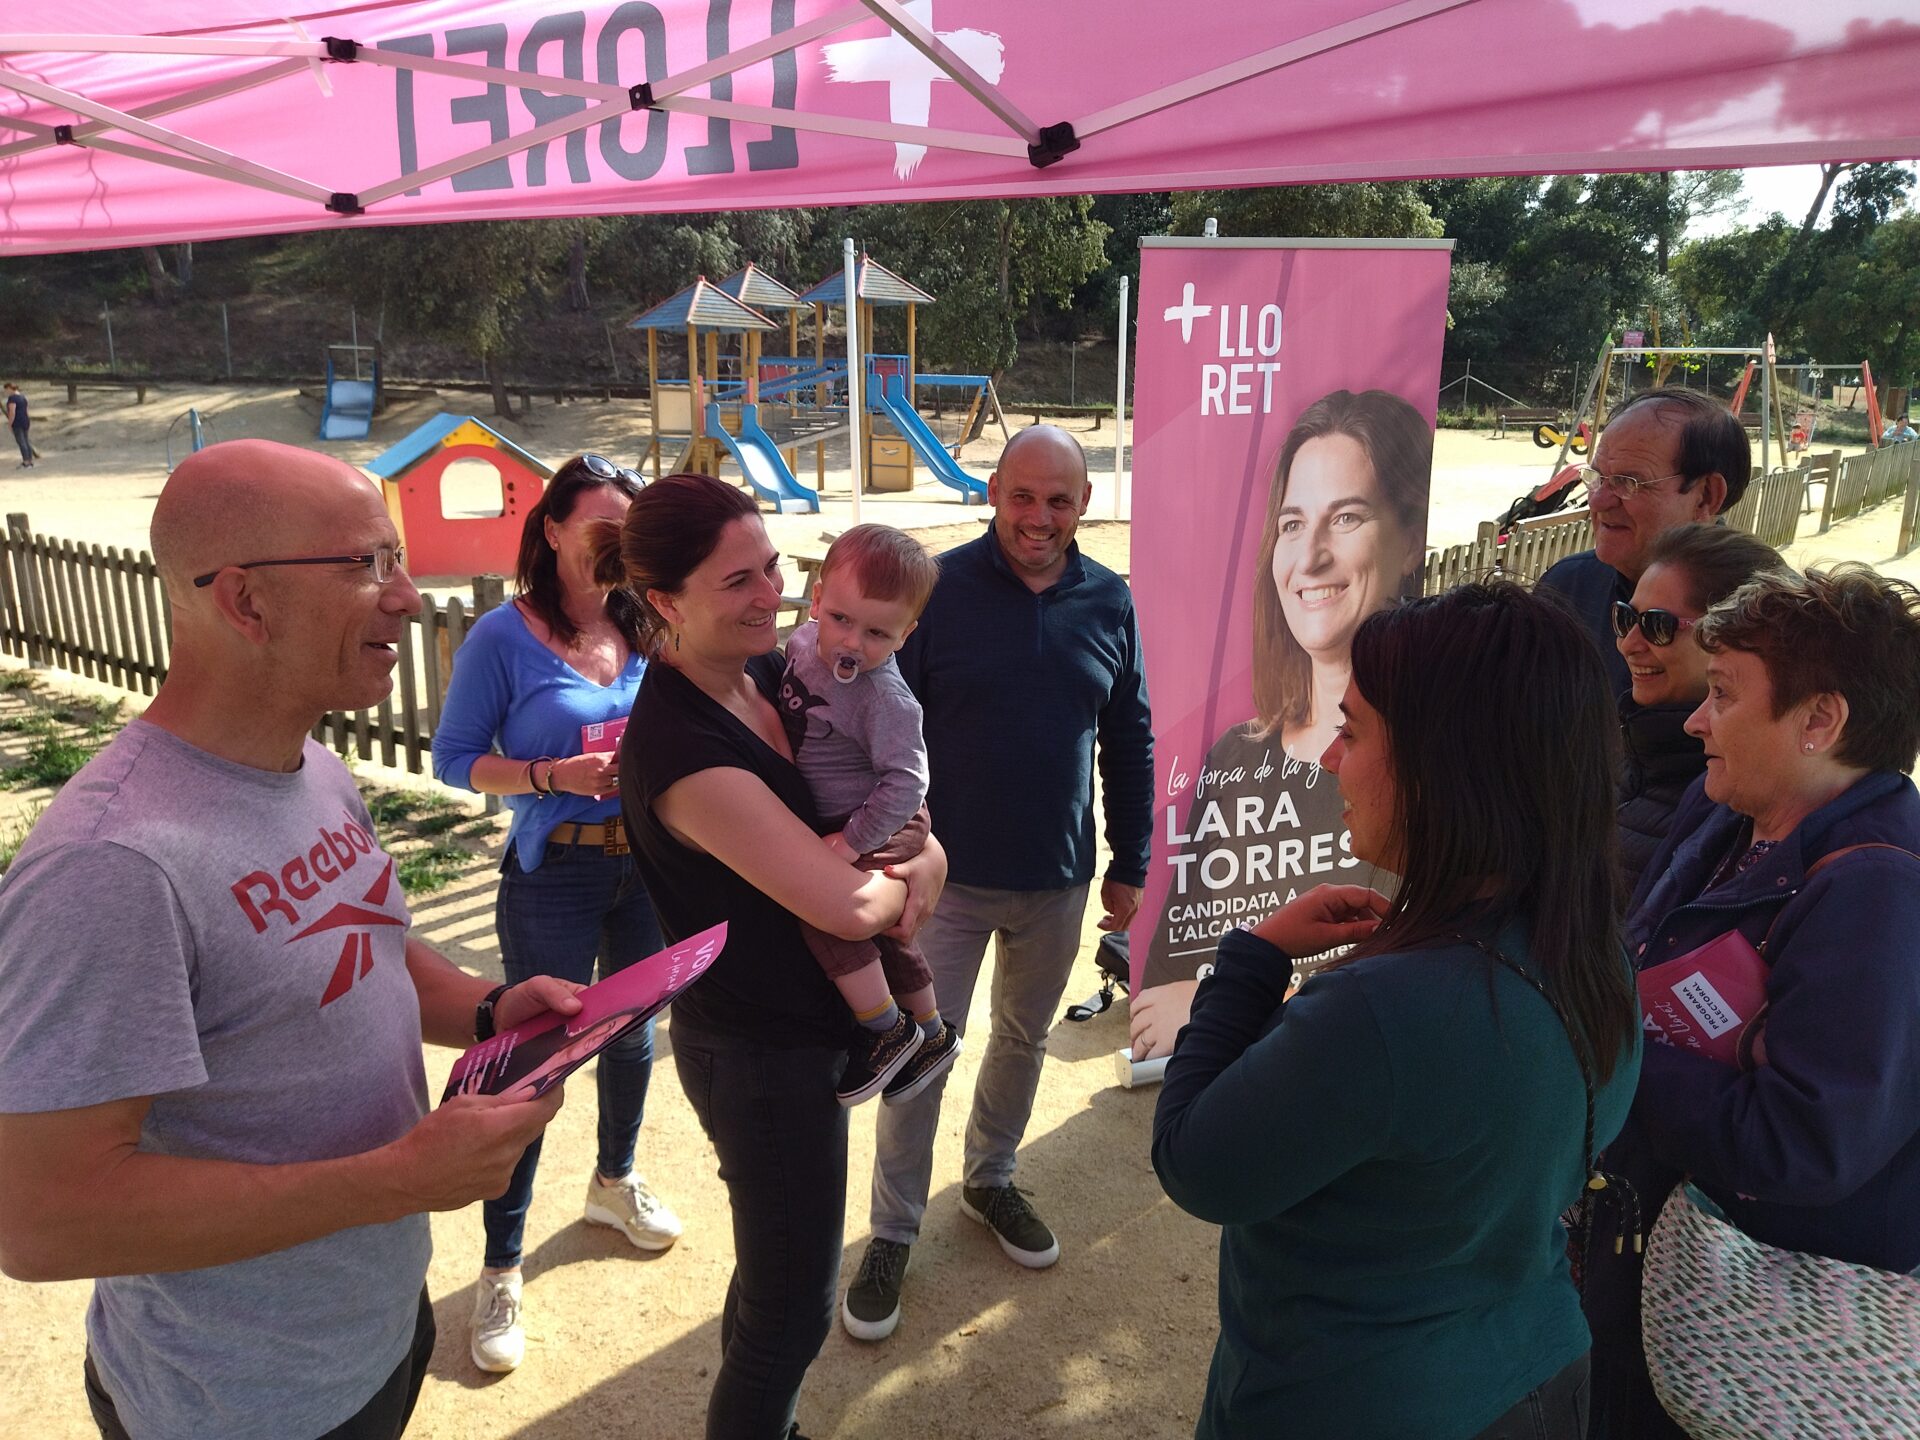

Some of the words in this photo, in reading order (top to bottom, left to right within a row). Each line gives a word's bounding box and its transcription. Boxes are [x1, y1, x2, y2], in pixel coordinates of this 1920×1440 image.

[1219, 304, 1282, 357] LLO
[1200, 362, 1281, 416] RET
[1197, 764, 1247, 799] força
[1254, 749, 1274, 783] de
[1281, 745, 1302, 780] la
[1166, 790, 1301, 846] LARA
[1167, 829, 1361, 894] TORRES
[1168, 891, 1280, 923] CANDIDATA
[1285, 886, 1297, 905] A
[1168, 911, 1273, 944] L'ALCAD
[1654, 1000, 1691, 1034] Lloret
[1682, 986, 1720, 1030] PROGRAMA
[1692, 981, 1729, 1024] ELECTORAL
